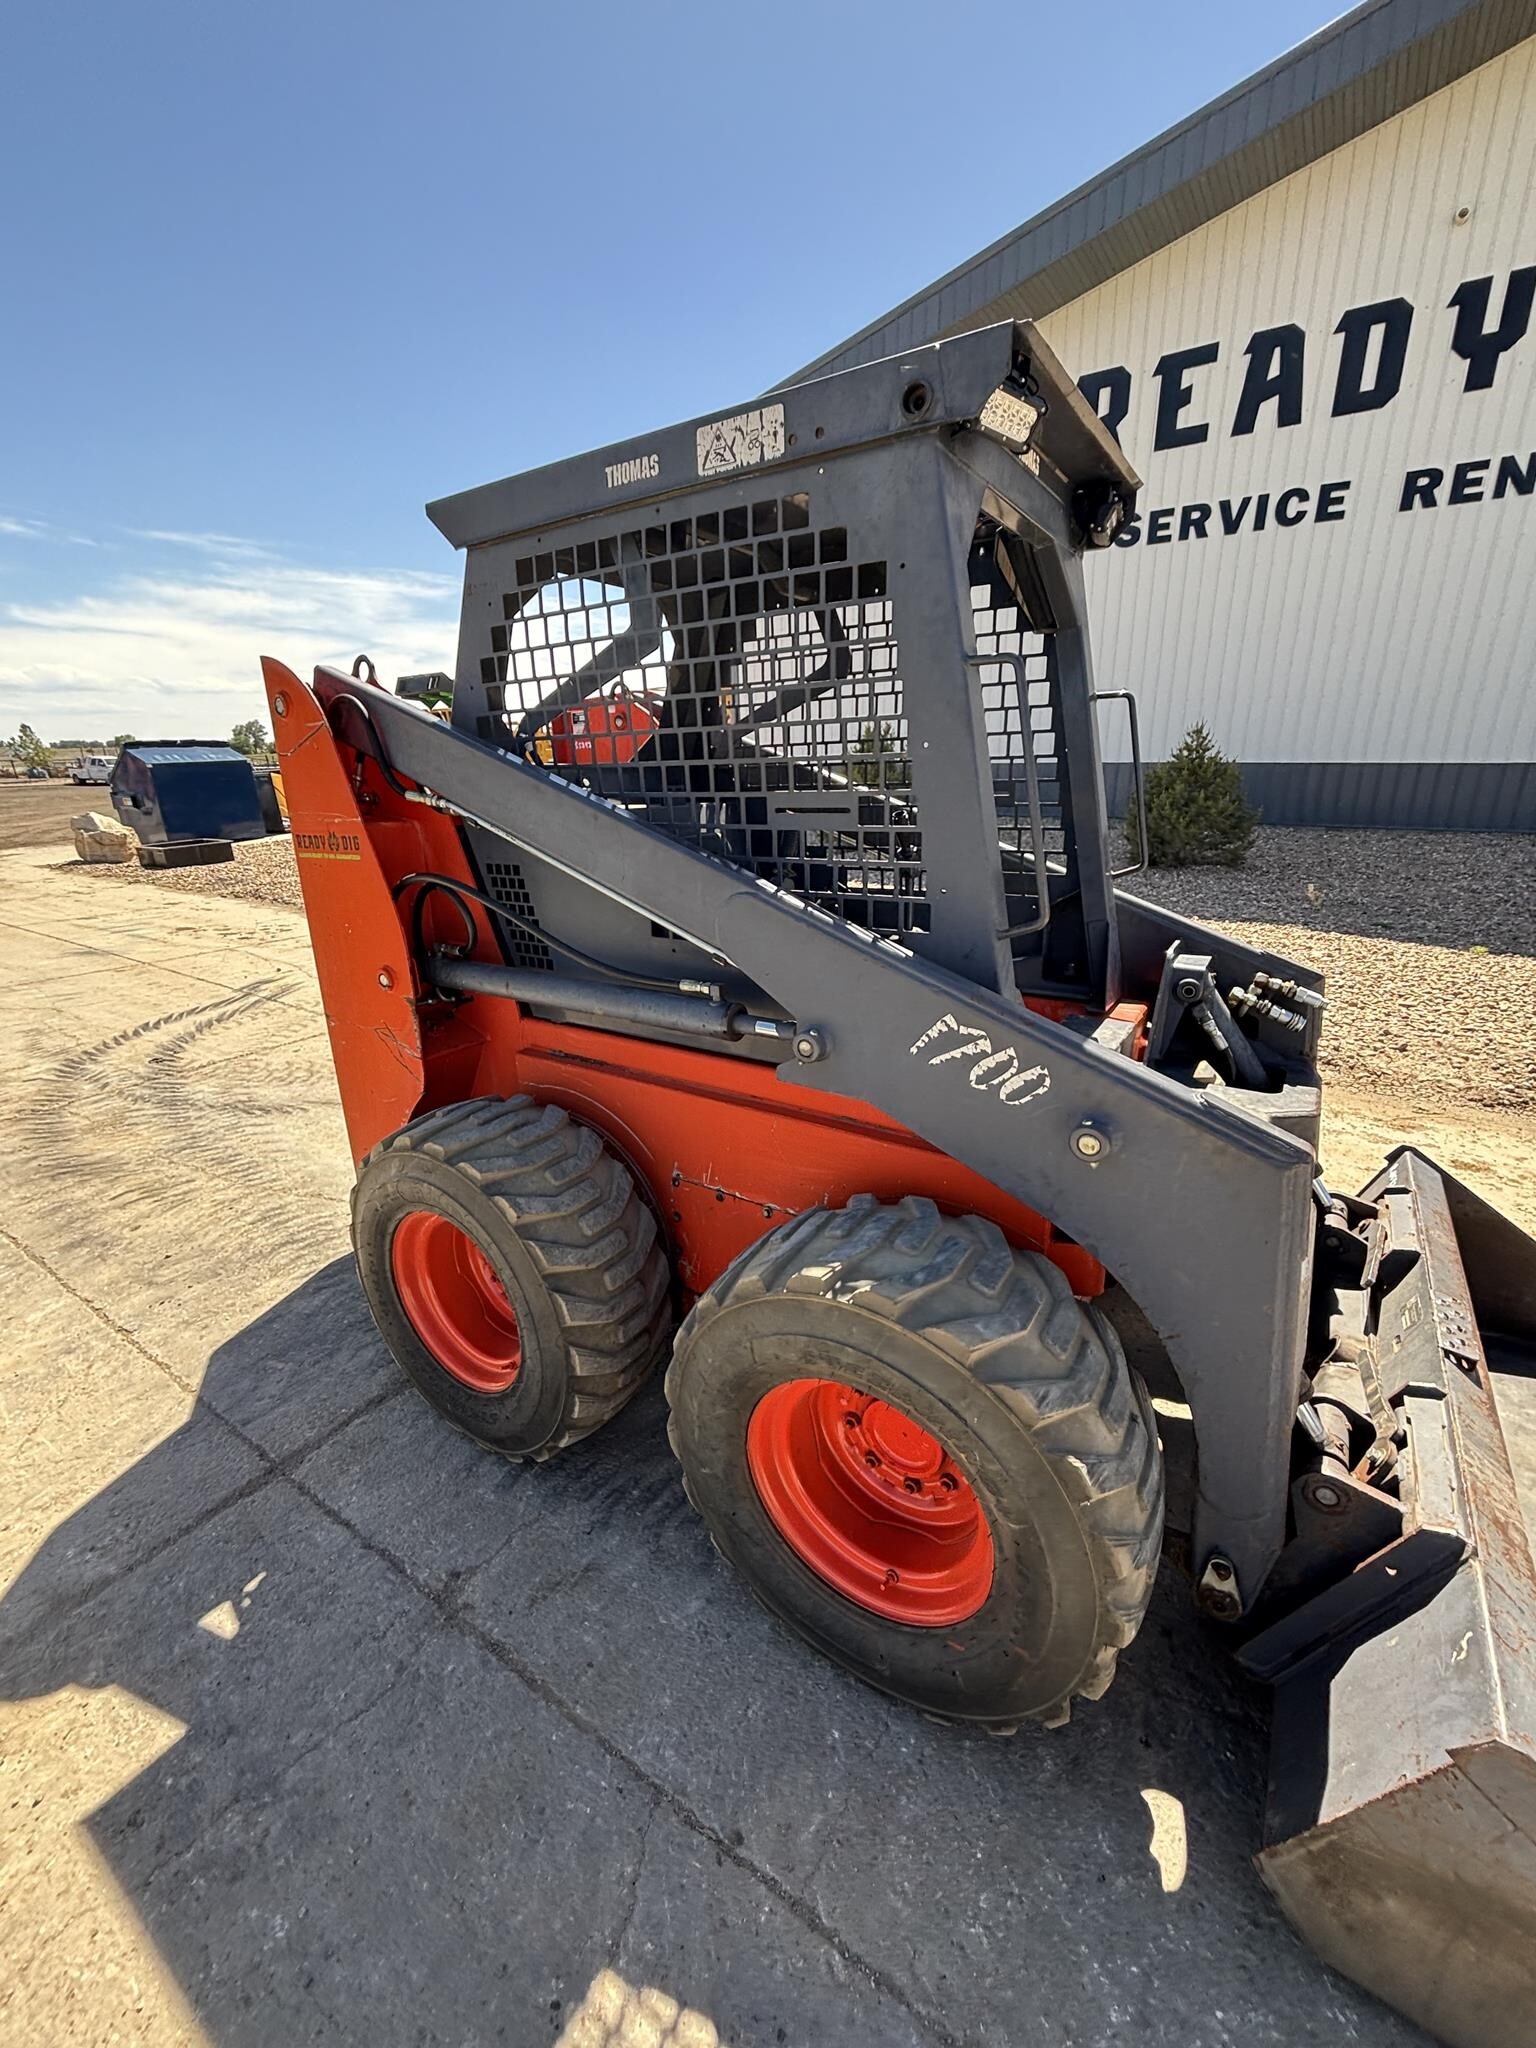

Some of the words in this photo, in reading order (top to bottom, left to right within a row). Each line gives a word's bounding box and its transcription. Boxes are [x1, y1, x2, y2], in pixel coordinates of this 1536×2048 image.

[605, 453, 660, 488] THOMAS
[1114, 480, 1351, 548] SERVICE
[1398, 451, 1536, 512] REN
[295, 833, 325, 850] READY
[341, 835, 360, 851] DIG
